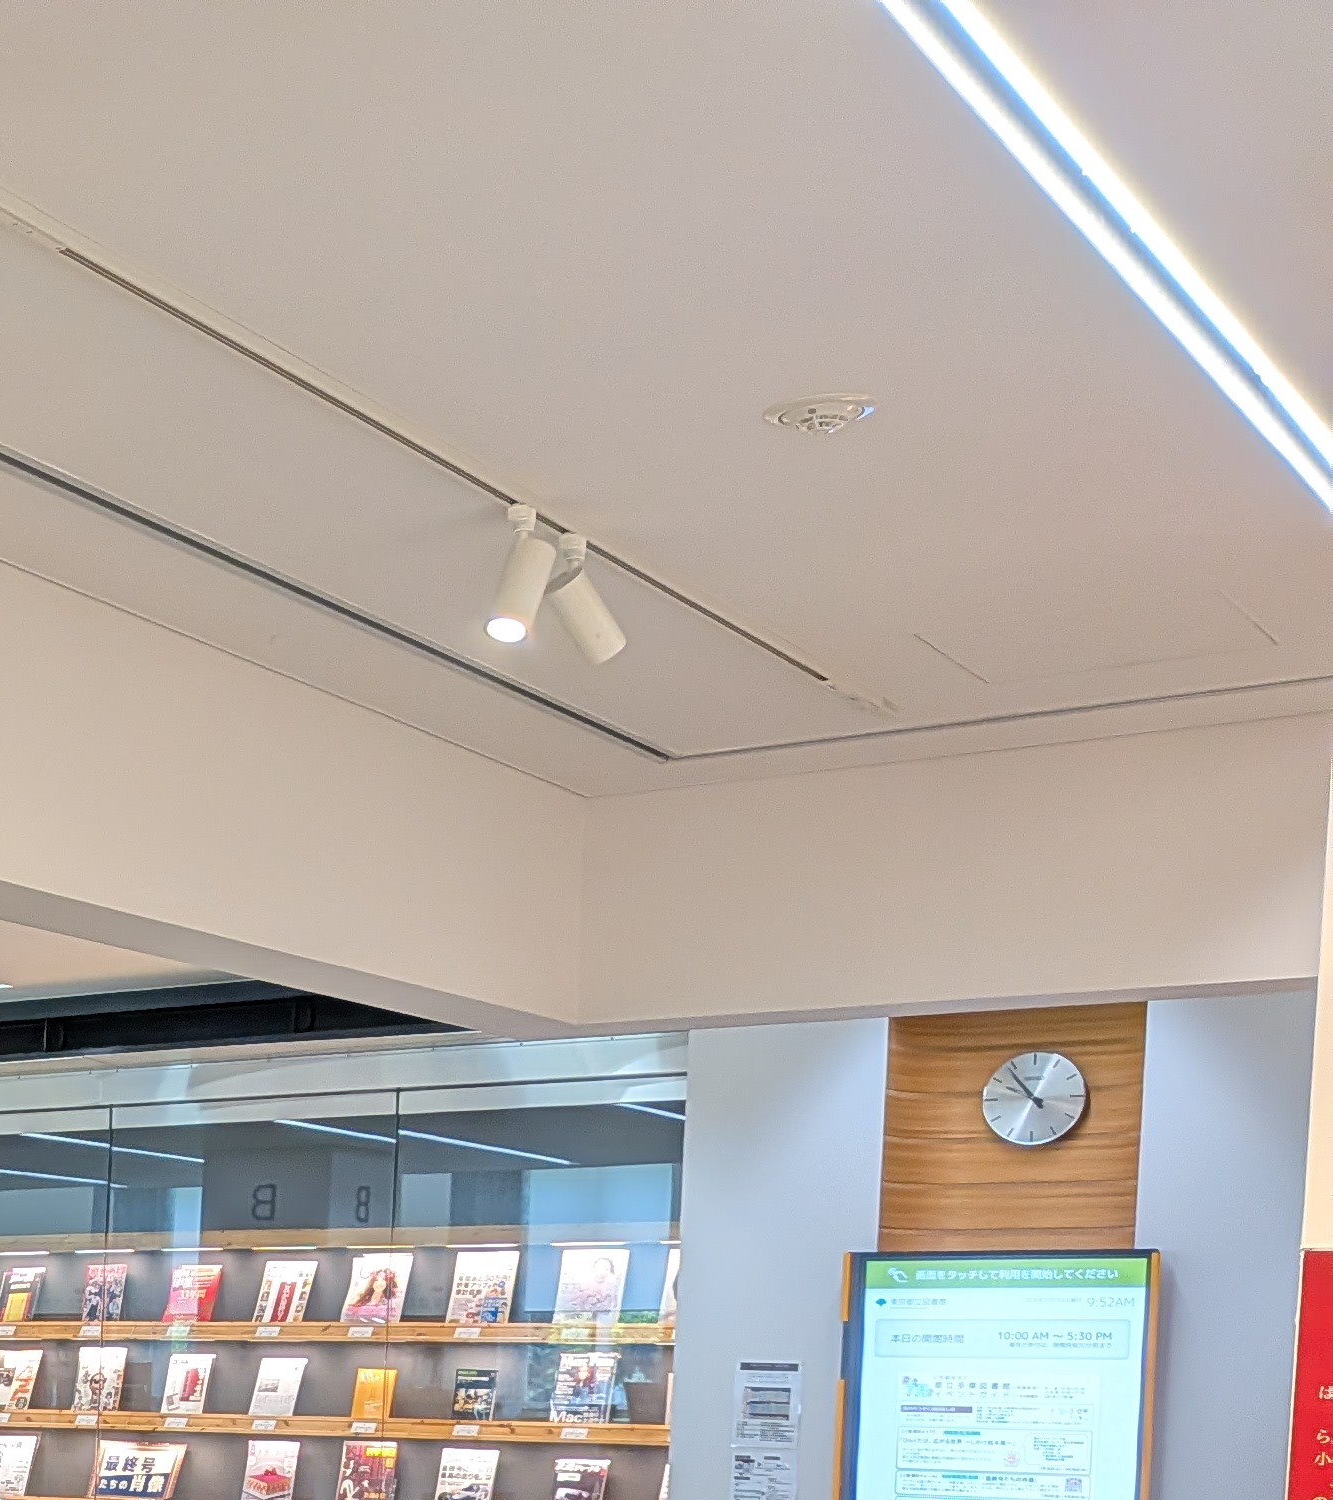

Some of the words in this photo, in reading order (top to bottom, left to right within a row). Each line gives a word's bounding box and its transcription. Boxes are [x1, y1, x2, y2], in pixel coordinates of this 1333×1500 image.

[997, 1331, 1029, 1341] 10:00
[1032, 1332, 1049, 1340] AM
[1067, 1331, 1096, 1340] 5:30
[1099, 1331, 1113, 1340] PM
[104, 1456, 156, 1471] 最終号
[99, 1475, 165, 1493] たちの肖像
